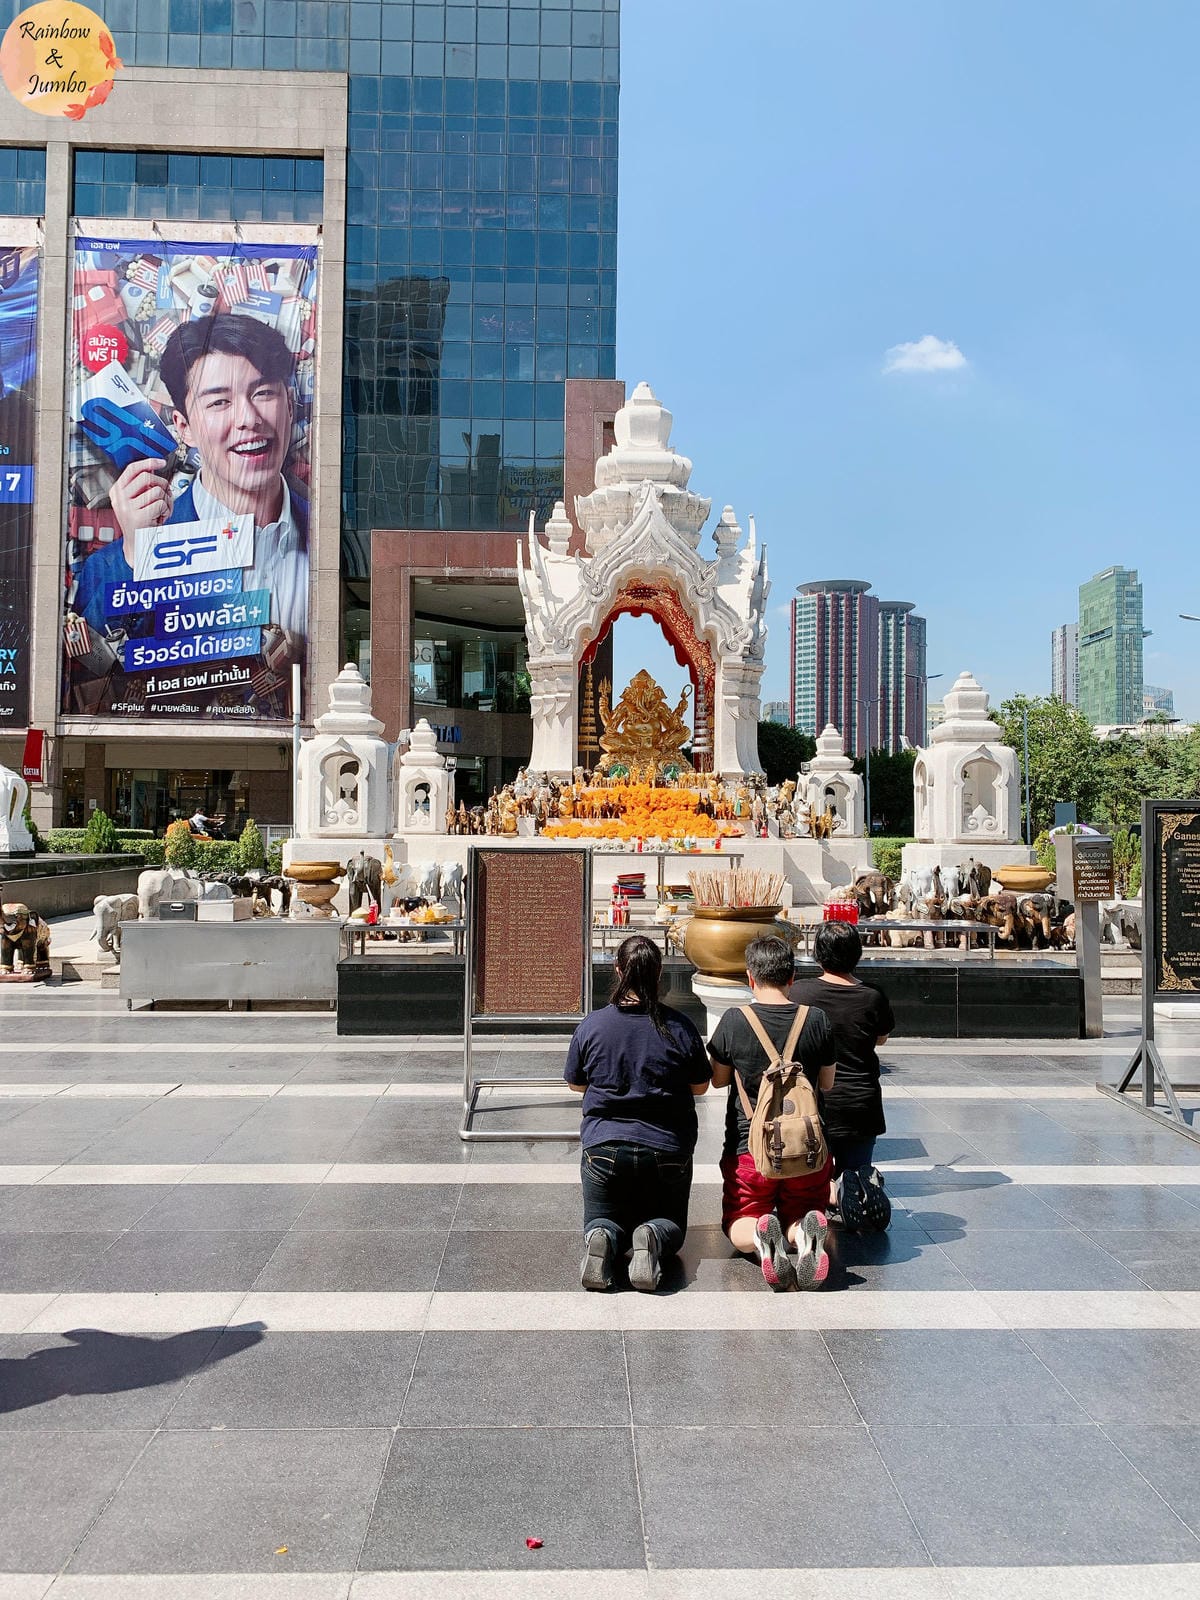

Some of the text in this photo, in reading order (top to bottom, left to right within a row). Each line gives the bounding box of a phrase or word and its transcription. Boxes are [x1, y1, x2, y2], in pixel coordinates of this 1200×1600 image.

[88, 334, 118, 347] สมัคร
[111, 578, 234, 609] ยิ่งดูหนังเยอะ
[133, 635, 253, 666] รีวอร์ดได้เยอะ
[146, 676, 155, 693] ที่
[158, 677, 180, 691] เอส
[183, 672, 208, 688] เอฟ
[111, 702, 145, 713] #SFplus
